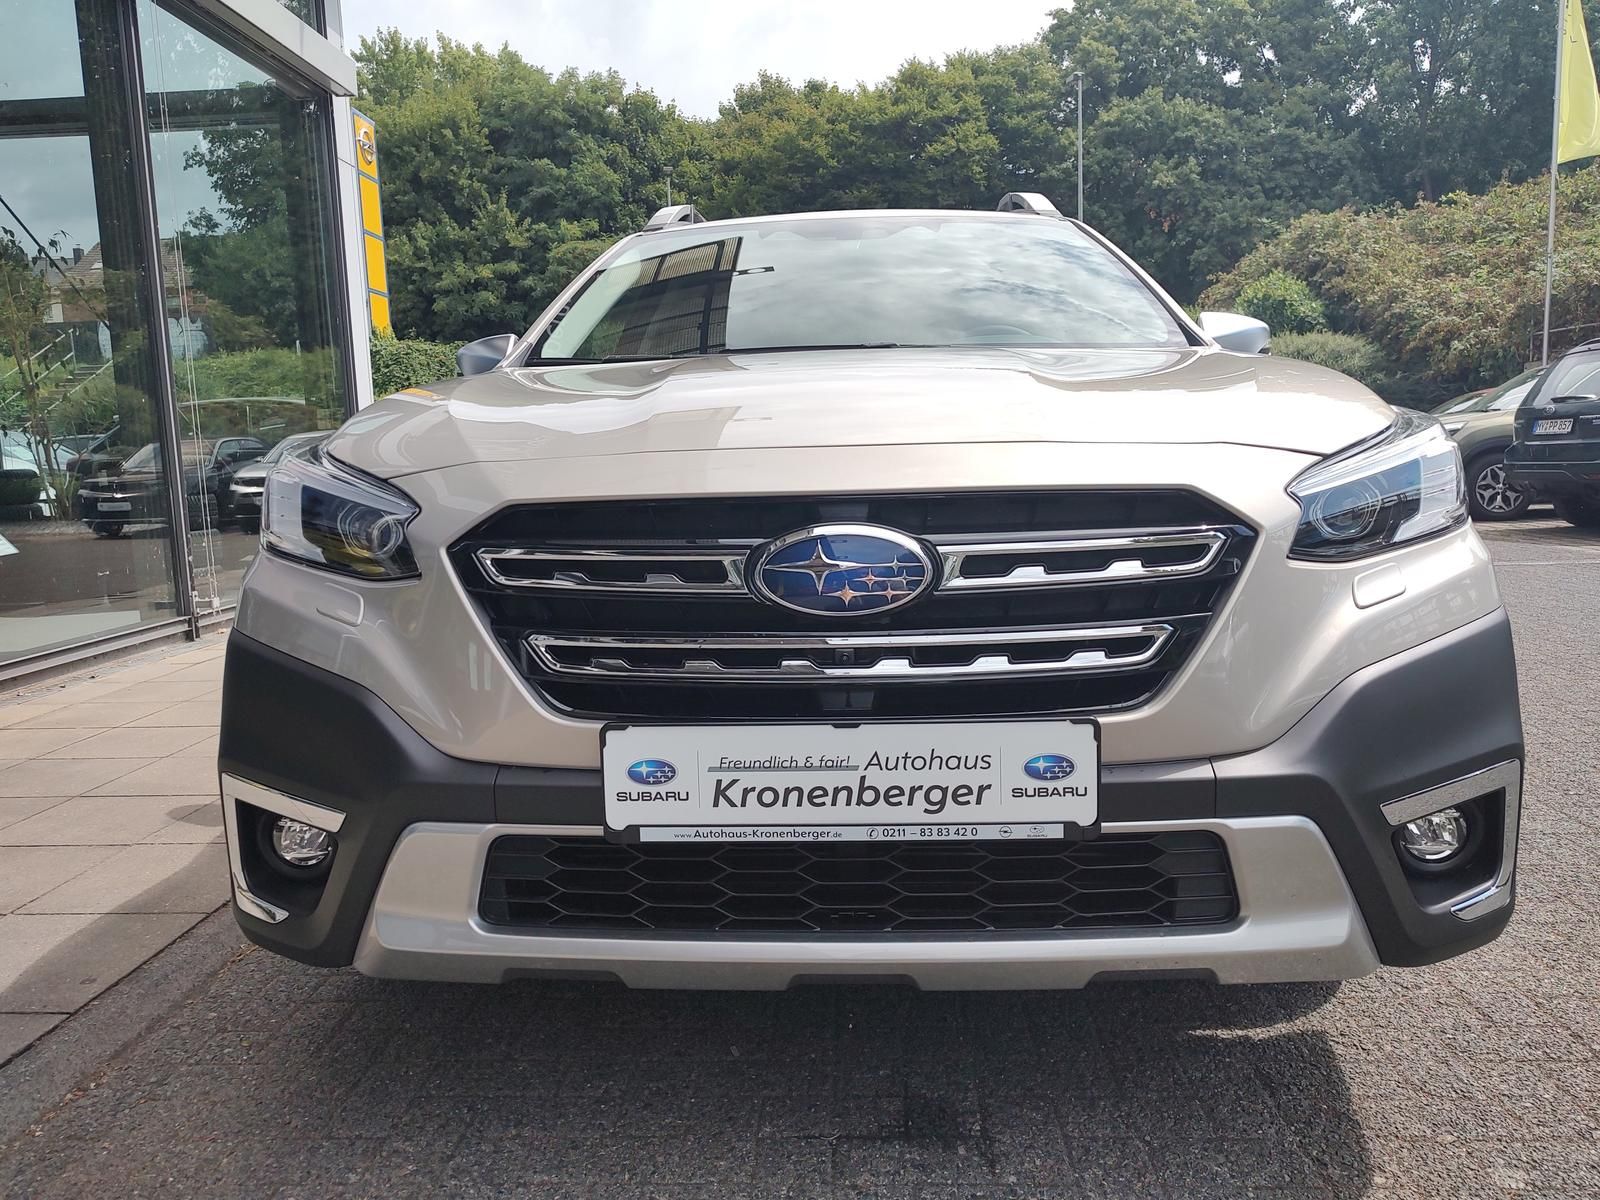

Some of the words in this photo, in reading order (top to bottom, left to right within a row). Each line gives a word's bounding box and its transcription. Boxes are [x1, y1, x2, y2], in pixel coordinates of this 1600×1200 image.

[719, 756, 798, 769] Freundlich
[803, 756, 814, 768] &
[819, 754, 850, 768] fair!
[864, 748, 992, 771] Autohaus
[616, 791, 689, 802] SUBARU
[712, 774, 992, 814] Kronenberger
[1011, 786, 1088, 798] SUBARU
[673, 829, 842, 840] www.Autohaus-Kronenberger.de
[882, 828, 906, 838] 0211
[920, 828, 933, 837] 83
[936, 828, 951, 837] 83
[954, 828, 968, 837] 42
[970, 828, 978, 837] 0
